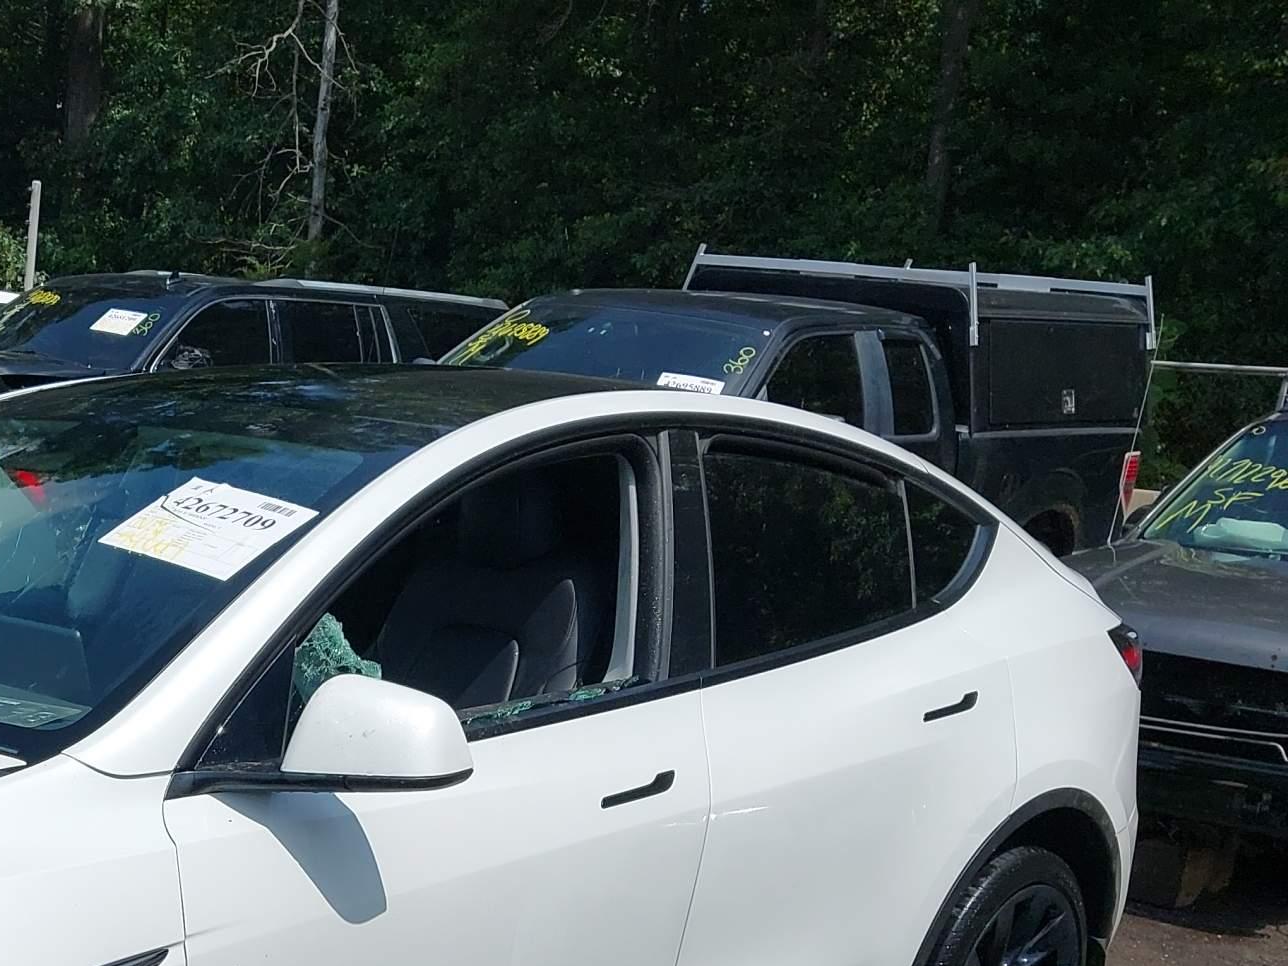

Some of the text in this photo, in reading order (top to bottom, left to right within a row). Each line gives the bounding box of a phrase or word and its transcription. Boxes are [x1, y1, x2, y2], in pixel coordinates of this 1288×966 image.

[132, 312, 161, 336] 360
[722, 346, 756, 375] 360
[173, 495, 278, 531] 42672709
[1154, 499, 1212, 534] M
